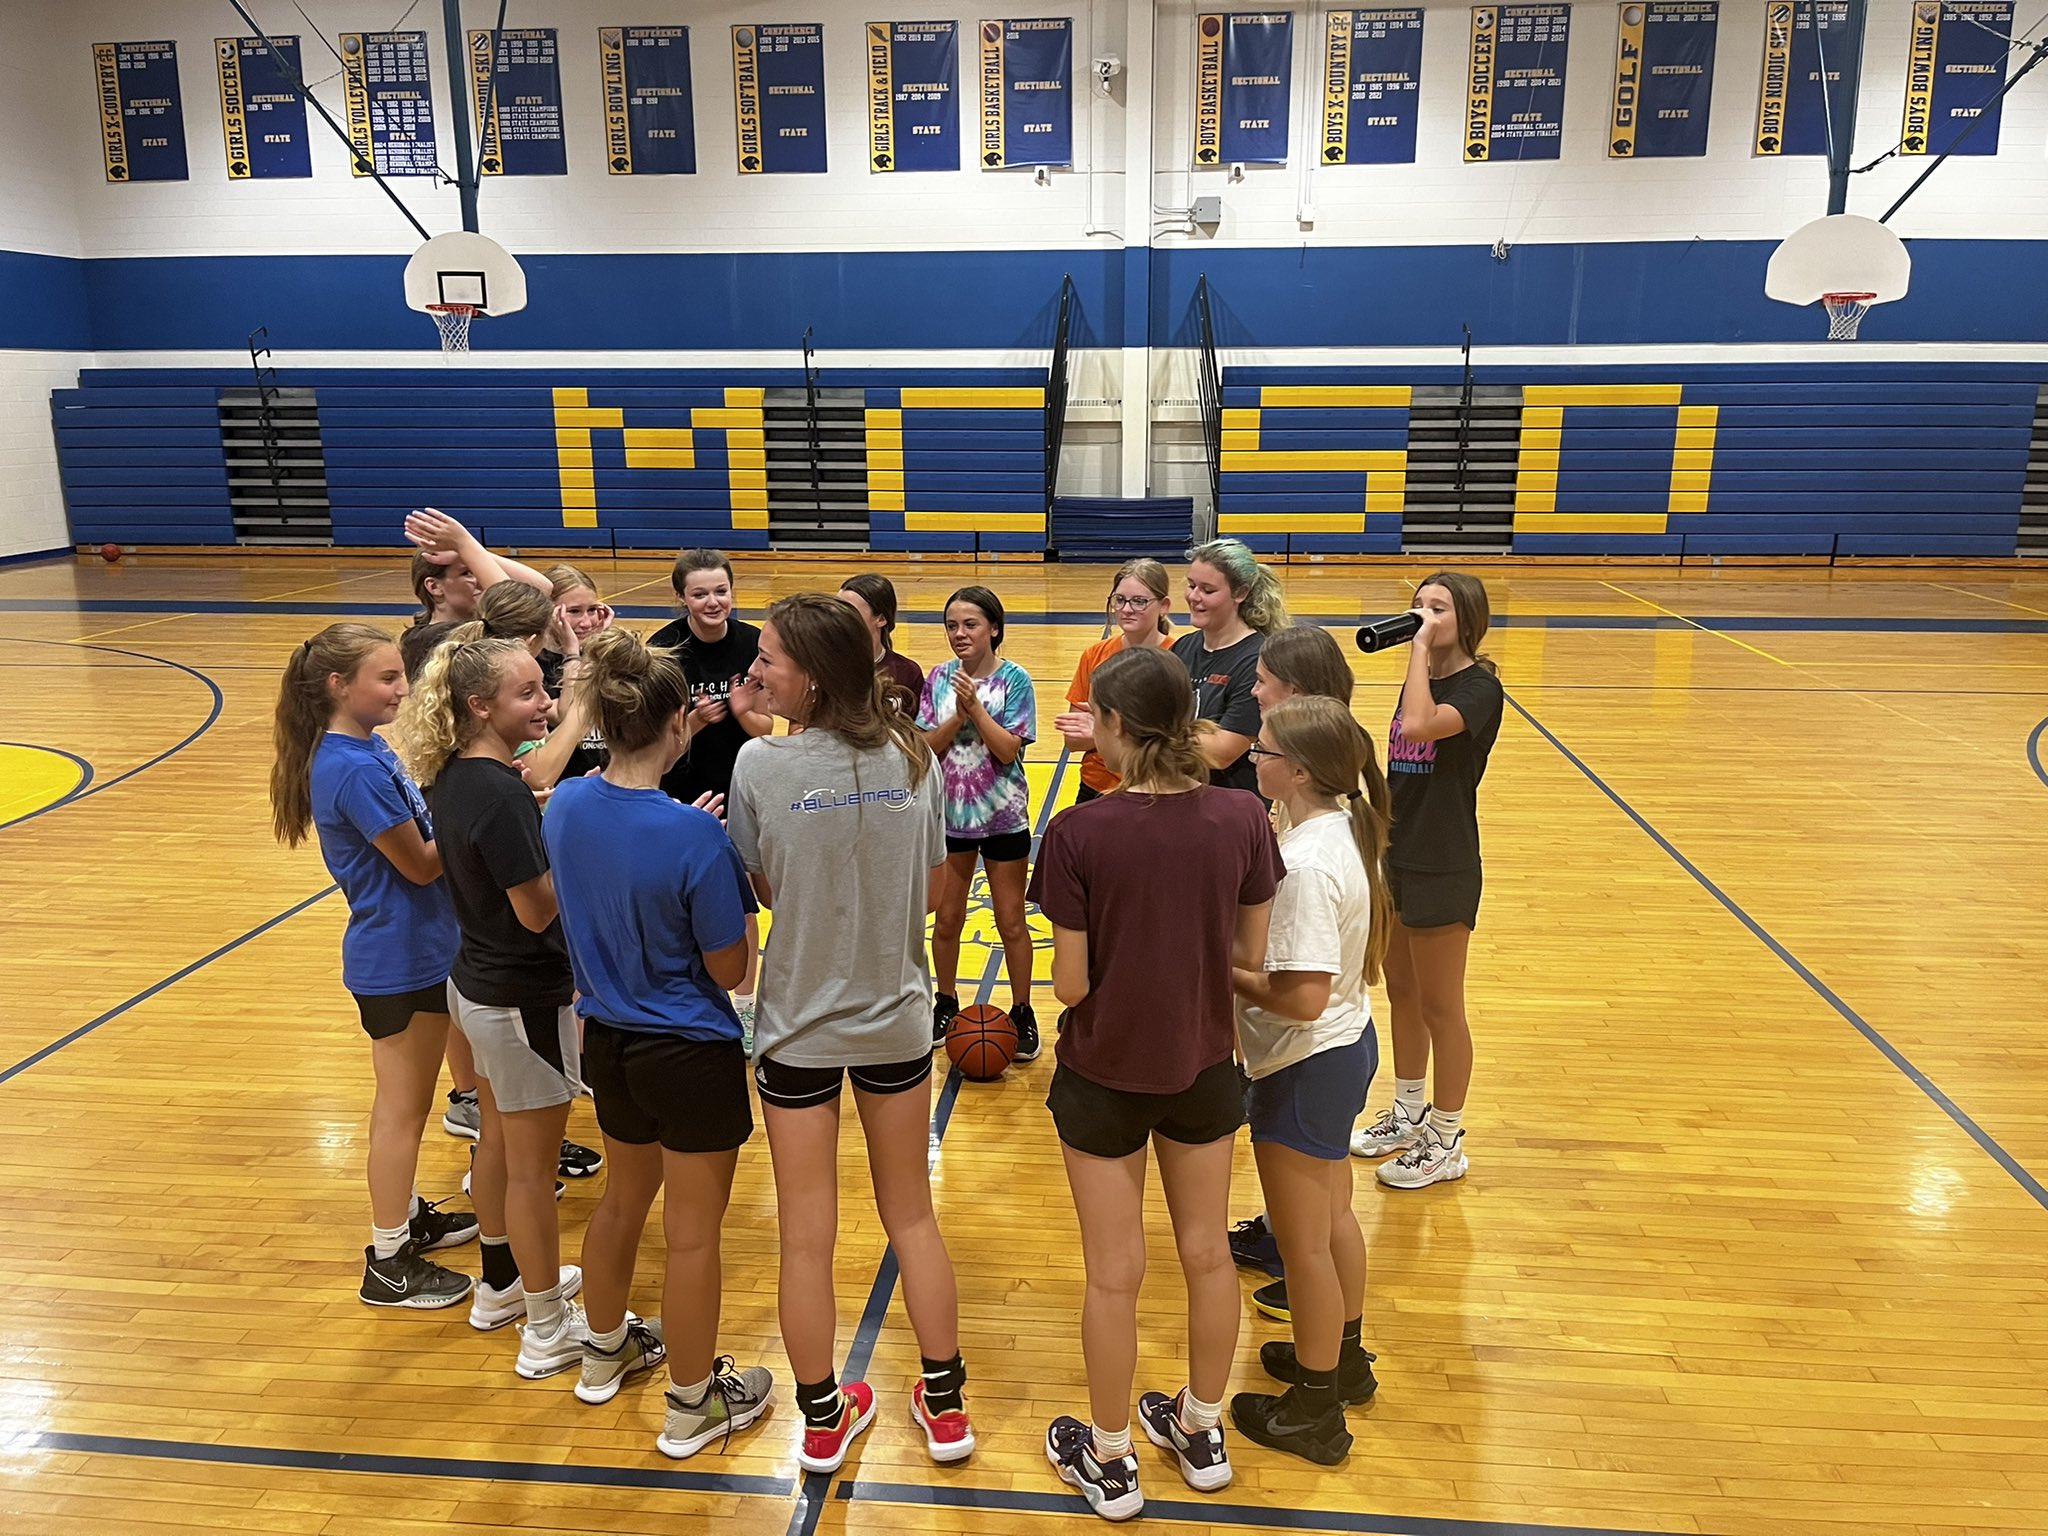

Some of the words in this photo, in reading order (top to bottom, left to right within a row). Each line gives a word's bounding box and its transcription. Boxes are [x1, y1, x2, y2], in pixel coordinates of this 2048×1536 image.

[1505, 7, 1563, 16] CONFERENCE
[1654, 4, 1712, 13] CONFERENCE
[1948, 4, 2007, 12] CONFERENCE
[1232, 15, 1286, 24] CONFERENCE
[1360, 11, 1417, 20] CONFERENCE
[898, 24, 952, 32] CONFERENCE
[1010, 21, 1065, 30] CONFERENCE
[501, 30, 546, 39] SECTIONAL
[630, 29, 682, 37] CONFERENCE
[763, 26, 816, 35] CONFERENCE
[1771, 27, 1787, 50] SKI
[122, 44, 169, 52] CONFERENCE
[475, 53, 490, 73] SKI
[872, 45, 888, 75] FIELD
[1473, 34, 1491, 94] SOCCER
[1912, 27, 1934, 93] BOWLING
[1329, 34, 1347, 108] X-COUNTRY
[1504, 69, 1555, 78] SECTIONAL
[1652, 65, 1703, 75] SECTIONAL
[1945, 64, 1996, 74] SECTIONAL
[1202, 41, 1218, 115] BASKETBALL
[1360, 72, 1409, 82] SECTIONAL
[1766, 52, 1785, 98] NORDIC
[1809, 72, 1840, 80] STTE
[606, 52, 624, 112] BOWLING
[736, 49, 756, 115] SOFTBALL
[876, 77, 887, 85] &
[984, 46, 1000, 117] BASKETBALL
[1232, 76, 1280, 85] SECTIONAL
[1616, 39, 1638, 127] GOLF
[221, 61, 242, 116] SOCCER
[768, 86, 815, 94] SECTIONAL
[902, 83, 949, 92] SECTIONAL
[1014, 81, 1062, 90] SECTIONAL
[1404, 82, 1417, 90] 1997
[377, 91, 421, 99] SECTIONAL
[637, 88, 682, 96] SECTIONAL
[100, 64, 121, 130] X-COUNTRY
[252, 94, 295, 103] SECTIONAL
[515, 96, 543, 104] STATE
[130, 98, 172, 107] SECTIONAL
[873, 88, 889, 120] TRACK
[1658, 109, 1689, 119] STATE
[1950, 108, 1982, 117] STATE
[1368, 117, 1398, 126] STATE
[1470, 100, 1487, 140] BOYS
[1512, 113, 1542, 122] STATE
[1763, 103, 1780, 134] BOYS
[1908, 102, 1926, 133] BOYS
[1024, 124, 1052, 133] STATE
[1240, 120, 1269, 128] STATE
[1328, 112, 1343, 143] BOYS
[610, 116, 627, 154] GIRLS
[648, 130, 676, 138] STATE
[779, 128, 807, 137] STATE
[913, 126, 941, 135] STATE
[985, 118, 1000, 150] GIRLS
[1200, 117, 1216, 145] BOYS
[228, 120, 245, 159] GIRLS
[264, 135, 291, 143] STATE
[742, 117, 758, 154] GIRLS
[875, 121, 890, 151] GIRLS
[142, 138, 168, 147] STATE
[353, 127, 369, 157] GIRLS
[106, 131, 124, 164] GIRLS
[790, 789, 917, 811] #BLUEMAGI
